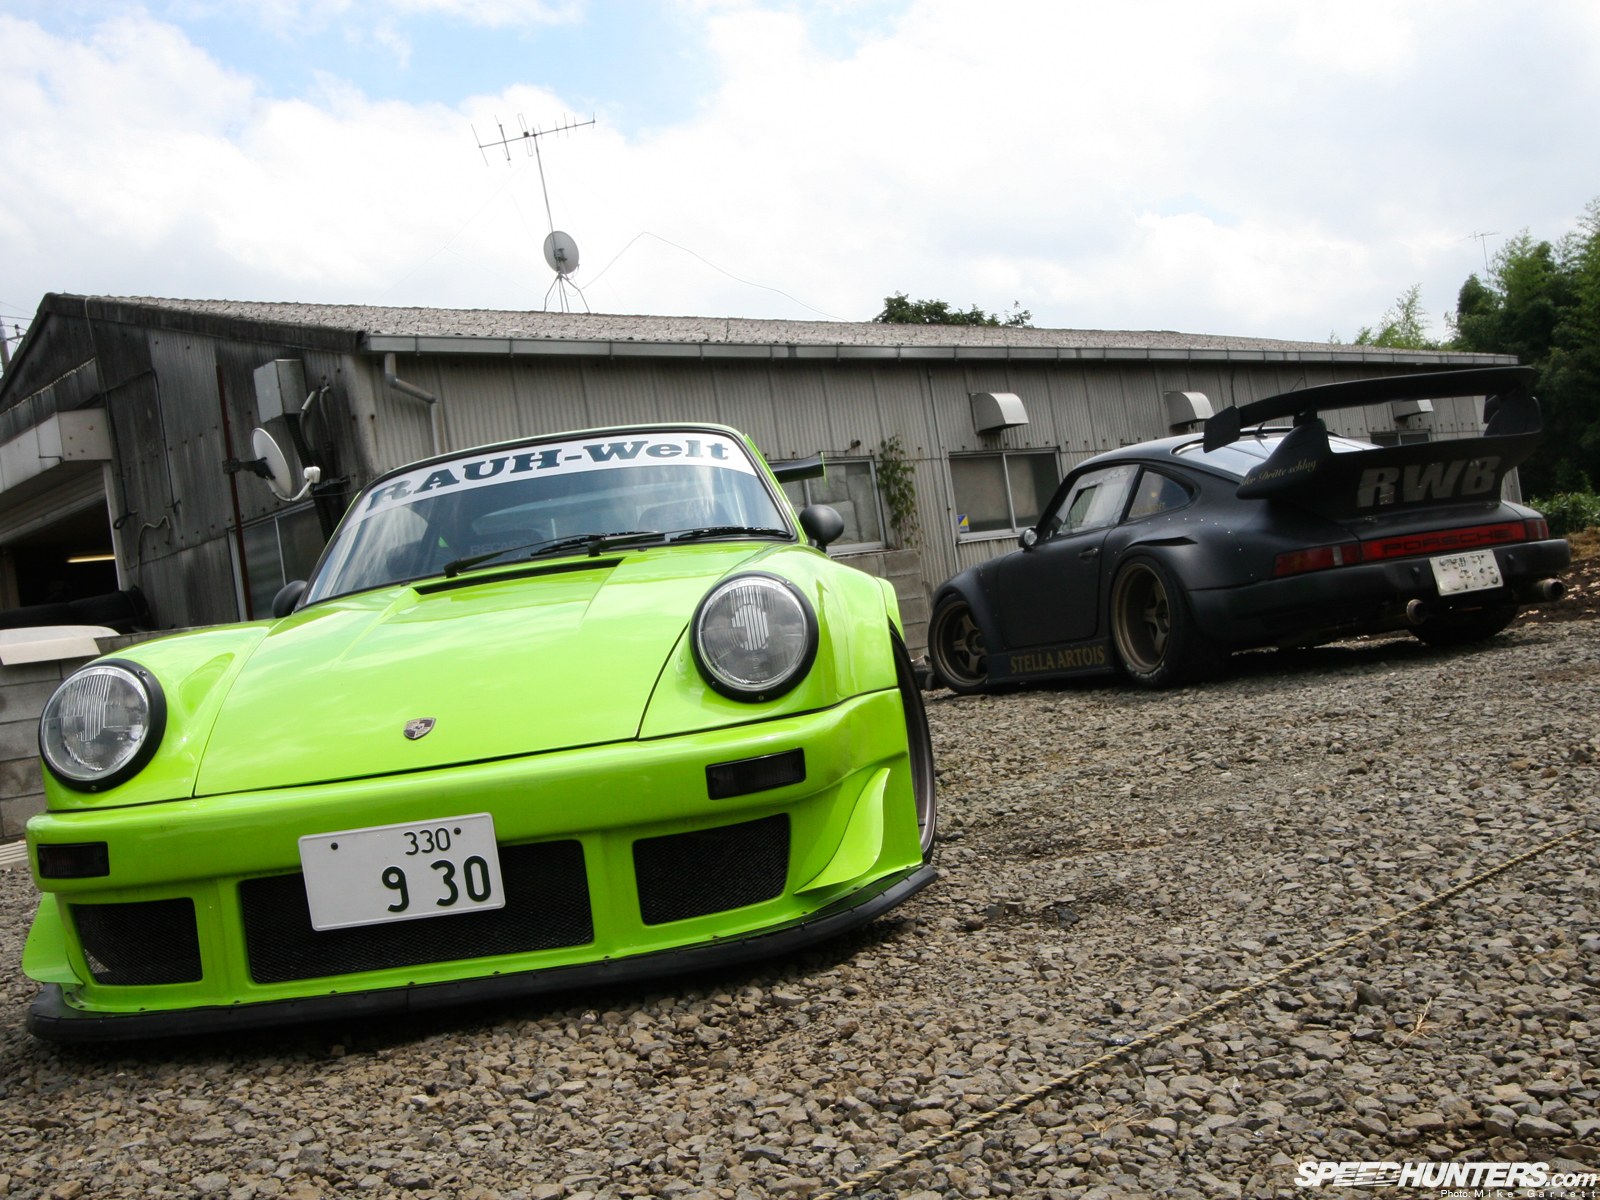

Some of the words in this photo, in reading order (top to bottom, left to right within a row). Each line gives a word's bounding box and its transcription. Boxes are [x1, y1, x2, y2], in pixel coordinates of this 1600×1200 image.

[365, 439, 730, 512] RAUH-Welt
[1356, 455, 1500, 508] RWB
[1383, 527, 1513, 554] PORSCHE
[1010, 653, 1056, 673] STELLA
[1057, 645, 1106, 668] ARTOIS
[403, 827, 451, 856] 330
